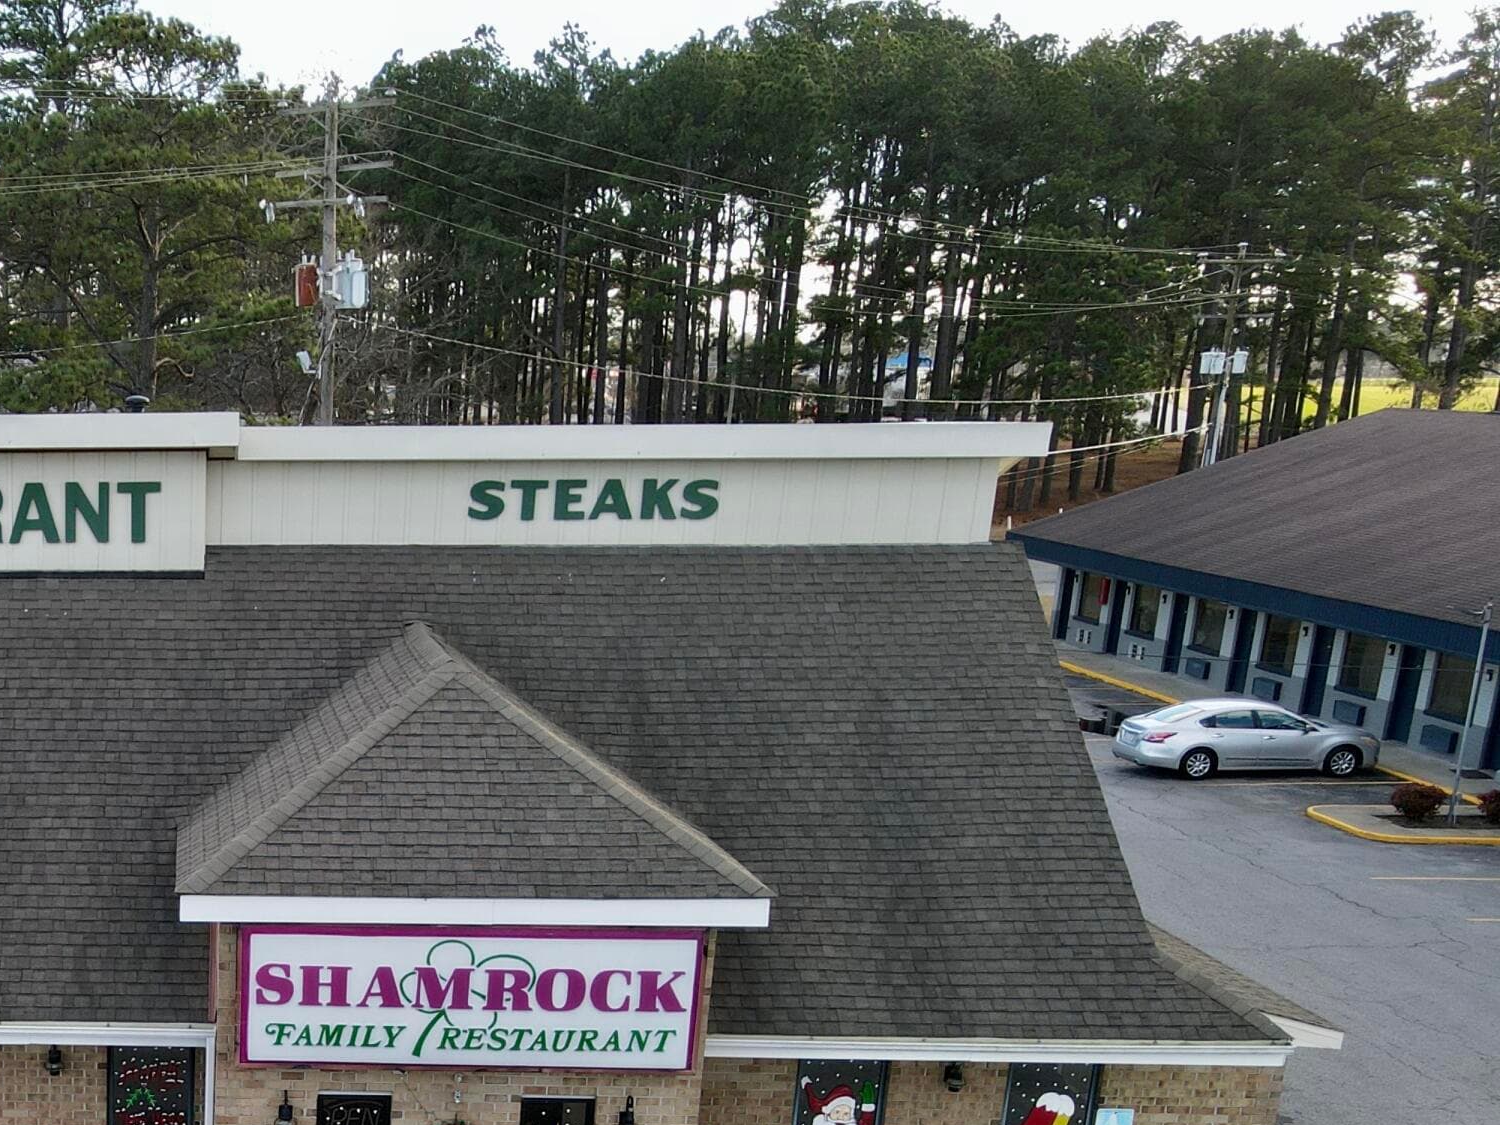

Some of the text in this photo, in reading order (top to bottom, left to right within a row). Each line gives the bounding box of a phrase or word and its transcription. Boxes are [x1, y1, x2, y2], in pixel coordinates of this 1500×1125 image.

[468, 478, 720, 521] STEAKS
[255, 963, 687, 1013] SHAMROCK
[265, 1022, 677, 1053] FAMILY RESTAURANT
